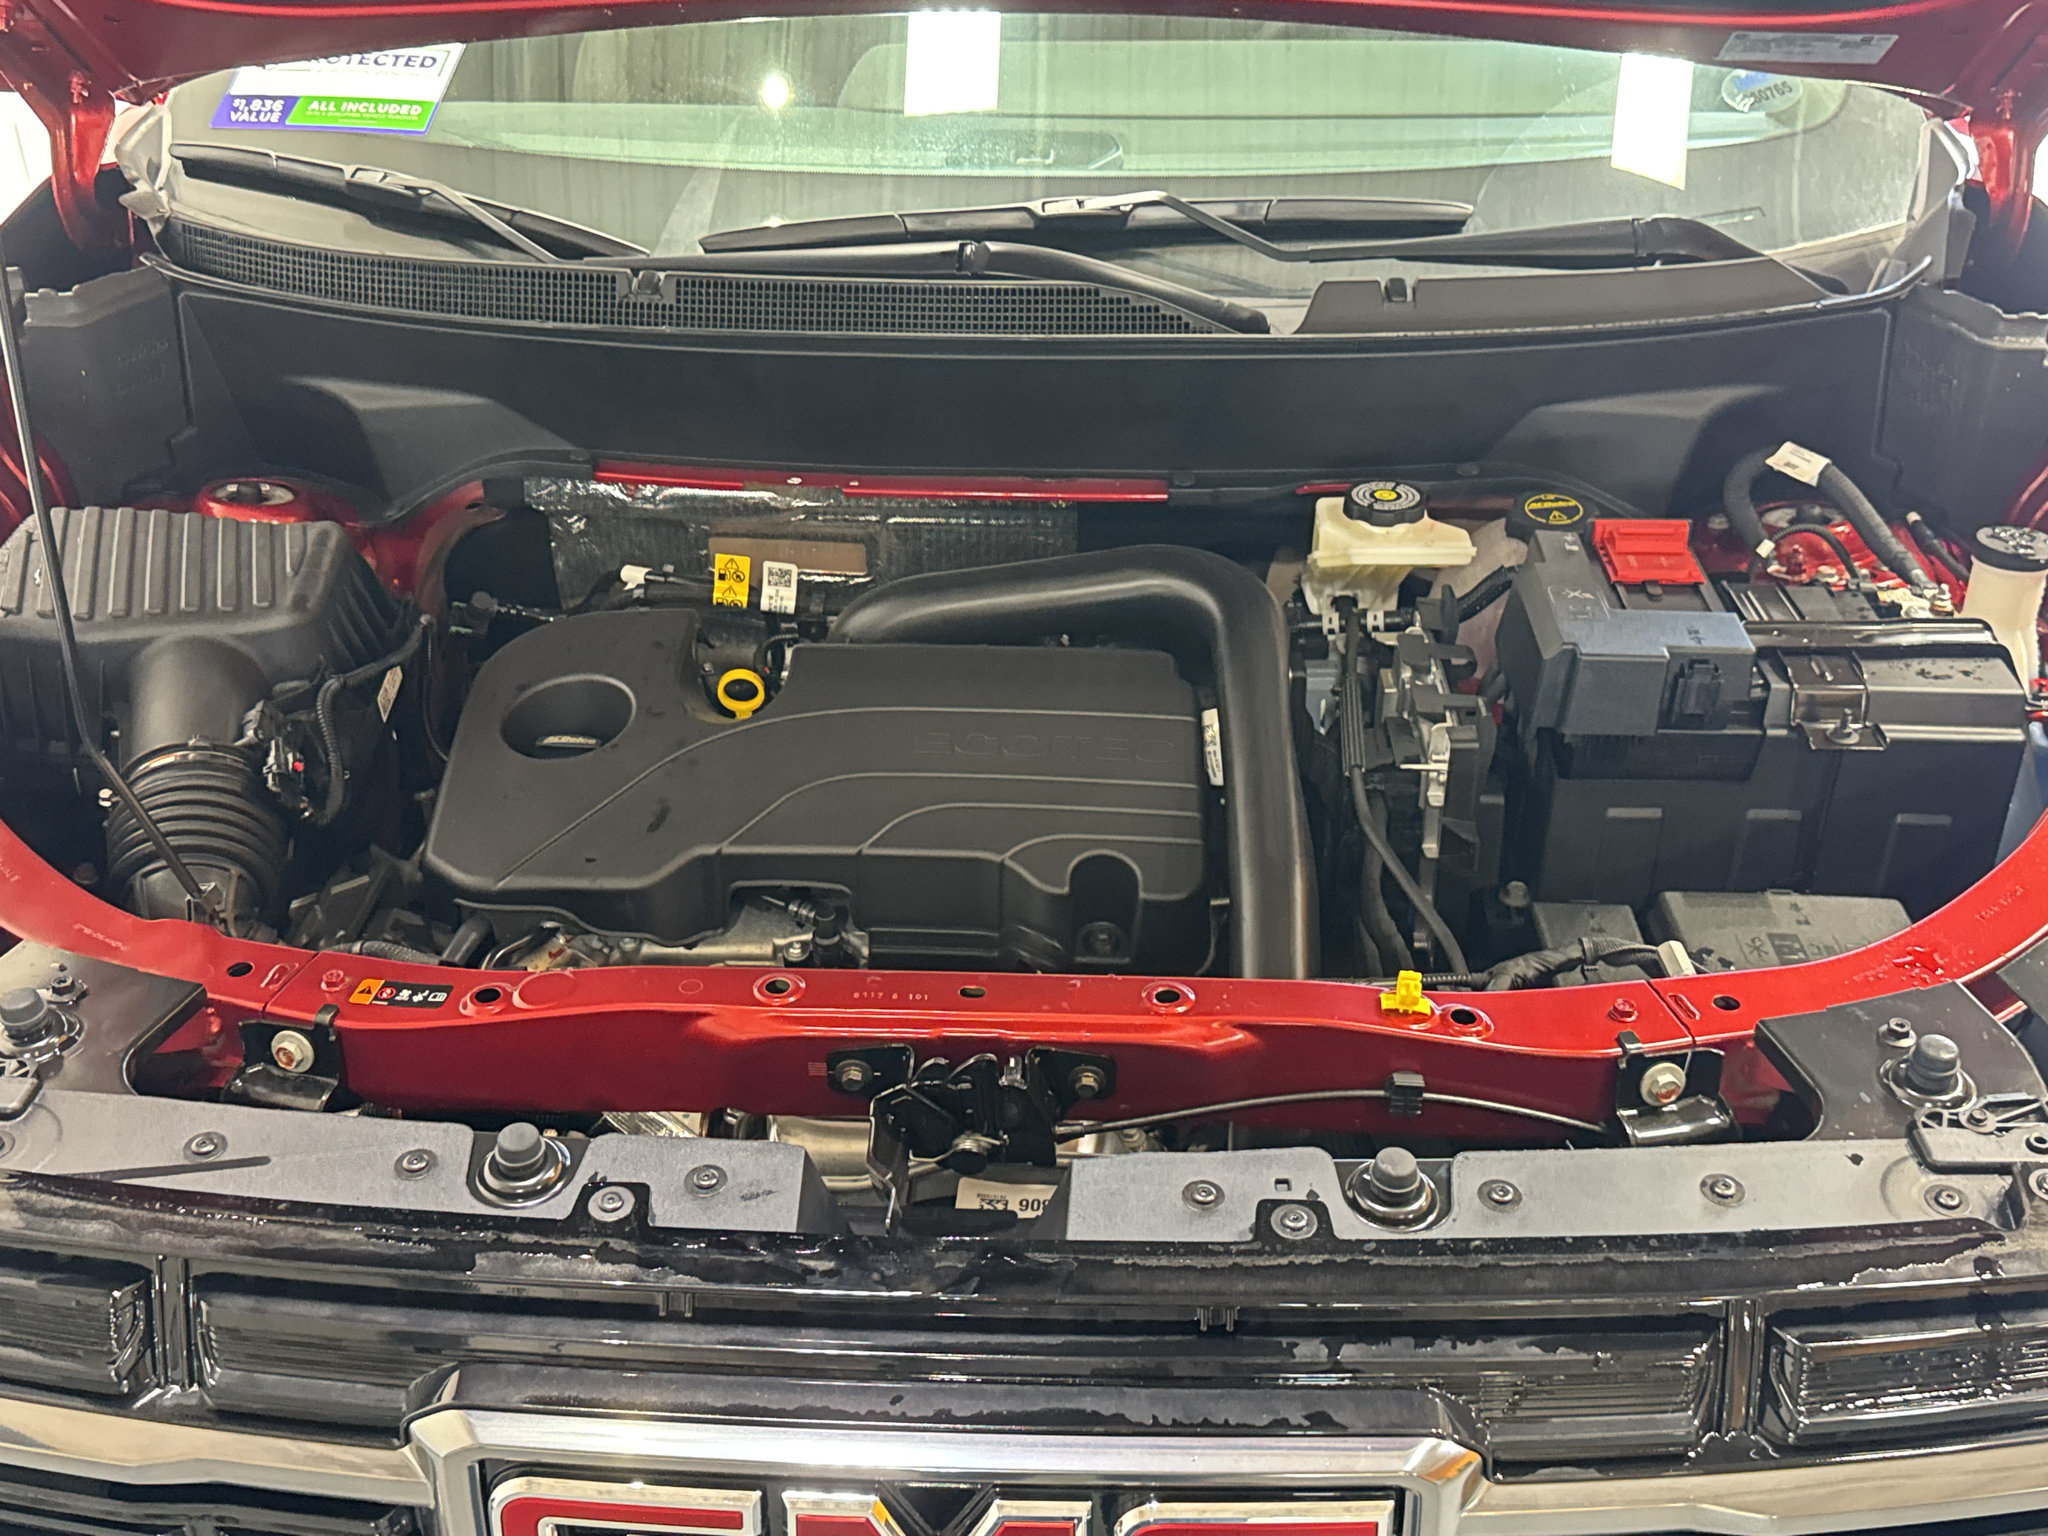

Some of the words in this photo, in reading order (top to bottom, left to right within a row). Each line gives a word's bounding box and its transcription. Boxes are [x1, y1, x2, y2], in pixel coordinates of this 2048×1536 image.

[318, 53, 438, 68] OTECTED
[232, 98, 285, 113] $1,836
[307, 100, 336, 112] ALL
[341, 101, 423, 115] INCLUDED
[230, 110, 282, 123] VALUE
